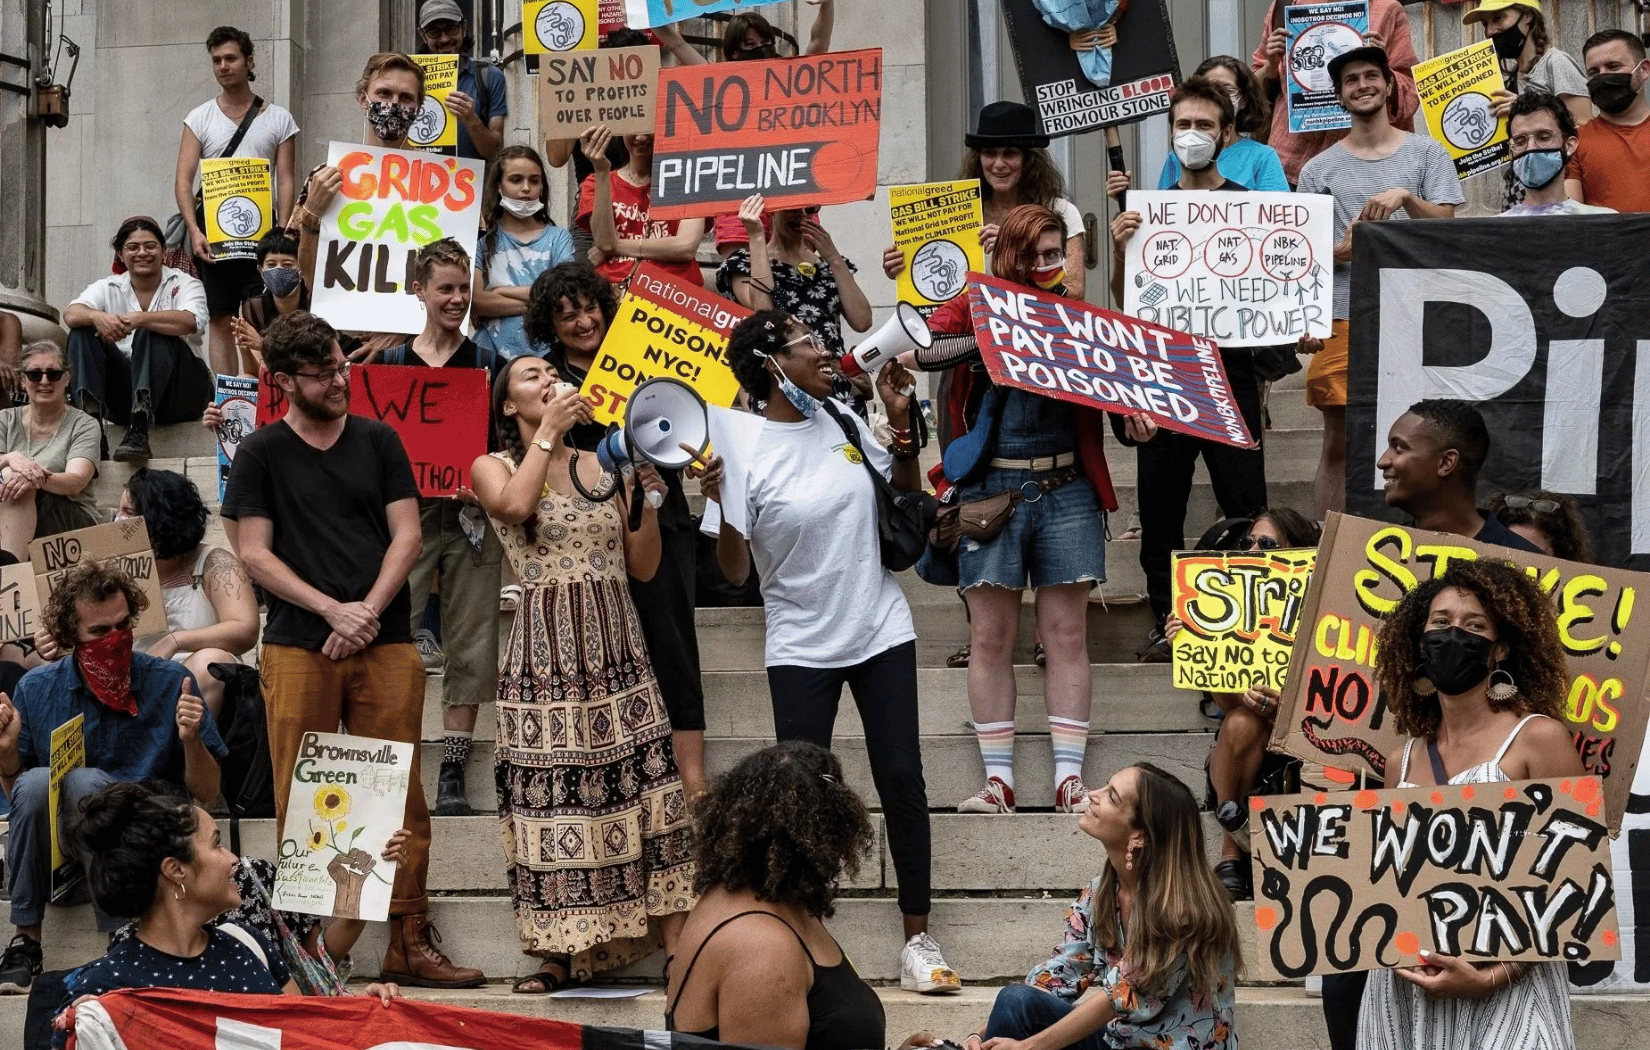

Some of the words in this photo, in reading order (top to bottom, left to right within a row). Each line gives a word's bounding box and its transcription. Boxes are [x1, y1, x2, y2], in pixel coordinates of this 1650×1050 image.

[426, 61, 456, 72] STRIKE
[547, 56, 597, 86] SAY
[608, 54, 644, 81] NO
[1414, 49, 1470, 74] nationalgreed
[1418, 75, 1436, 91] GAS
[1437, 65, 1458, 81] BILL
[1458, 48, 1492, 68] STRIKE
[1037, 80, 1074, 100] STOP
[1420, 89, 1434, 100] WE
[1434, 76, 1456, 91] WILL
[1457, 67, 1476, 80] NOT
[1476, 58, 1494, 70] PAY
[1427, 99, 1439, 108] TO
[1440, 92, 1452, 102] BE
[1452, 69, 1498, 94] POISONED.
[555, 90, 575, 103] TO
[586, 84, 648, 102] PROFITS
[664, 74, 751, 138] NO
[764, 56, 880, 101] NORTH
[1040, 88, 1120, 116] WRINGING
[1122, 76, 1172, 98] BLOOD
[1121, 93, 1170, 116] STONE
[556, 108, 592, 124] OVER
[598, 104, 646, 121] PEOPLE
[757, 96, 881, 132] BROOKLYN
[1459, 156, 1472, 165] Join
[1472, 152, 1482, 160] the
[1482, 143, 1503, 156] Strike!
[202, 170, 220, 181] GAS
[220, 168, 238, 178] BILL
[239, 164, 268, 174] STRIKE
[338, 152, 476, 212] GRID'S
[658, 148, 811, 198] PIPELINE
[206, 184, 227, 194] National
[891, 184, 953, 198] nationalgreed
[892, 206, 914, 218] GAS
[914, 199, 938, 214] BILL
[938, 189, 978, 206] STRIKE
[895, 218, 907, 226] WE
[908, 213, 926, 224] WILL
[927, 210, 942, 218] NOT
[942, 206, 958, 216] PAY
[958, 202, 972, 212] FOR
[1148, 202, 1178, 226] WE
[1188, 201, 1250, 225] DON'T
[1258, 203, 1310, 228] NEED
[337, 201, 444, 246] GAS
[894, 238, 912, 247] from
[912, 235, 924, 243] the
[924, 226, 956, 240] CLIMATE
[956, 220, 982, 232] CRISIS.
[895, 224, 924, 236] National
[925, 220, 940, 230] Grid
[949, 212, 975, 224] PROFIT
[1218, 236, 1242, 248] NAT
[1273, 236, 1299, 250] NBK
[1154, 254, 1178, 266] GRID
[1219, 253, 1238, 265] GAS
[1264, 254, 1308, 268] PIPELINE
[636, 272, 748, 330] nationalgr
[1176, 276, 1212, 303] WE
[1220, 278, 1279, 303] NEED
[980, 283, 1043, 328] WE
[1054, 302, 1174, 361] WON'T
[1137, 306, 1234, 340] PUBLIC
[1237, 304, 1328, 340] POWER
[643, 344, 702, 382] NYC!
[988, 316, 1056, 360] PAY
[1062, 339, 1117, 372] TO
[1126, 355, 1183, 391] BE
[362, 366, 449, 424] WE
[999, 351, 1200, 422] POISONED
[42, 536, 82, 571] NO
[1225, 645, 1254, 666] NO
[1262, 648, 1290, 666] to
[1178, 665, 1270, 688] National
[1304, 667, 1370, 722] NO
[300, 732, 398, 765] Brownsville
[294, 759, 358, 784] Green
[280, 838, 312, 858] Our
[1260, 804, 1352, 870] WE
[1363, 783, 1608, 898] WON'T
[1418, 862, 1614, 960] PAY!
